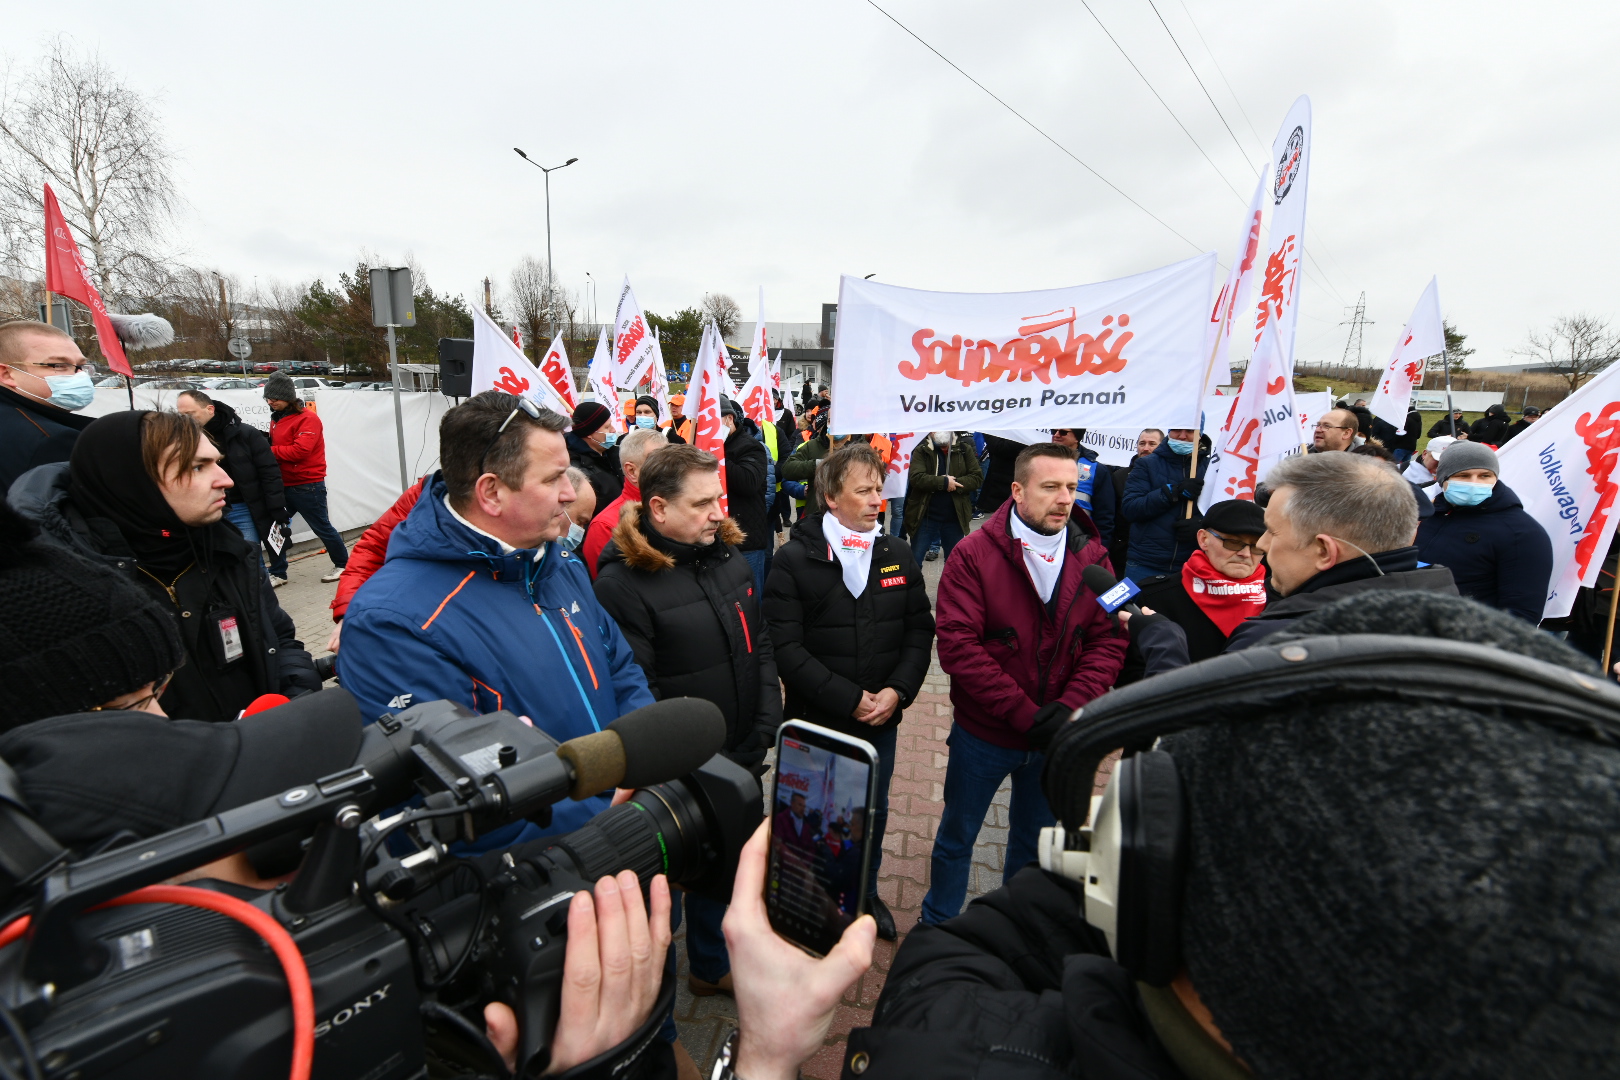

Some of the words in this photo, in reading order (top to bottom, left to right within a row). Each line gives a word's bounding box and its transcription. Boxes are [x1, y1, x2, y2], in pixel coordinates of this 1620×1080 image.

[899, 394, 1032, 414] Volkswagen
[1040, 385, 1126, 407] Poznań
[1109, 436, 1138, 451] OŚWIA
[1539, 442, 1583, 535] Volkswagen
[314, 983, 392, 1039] SONY
